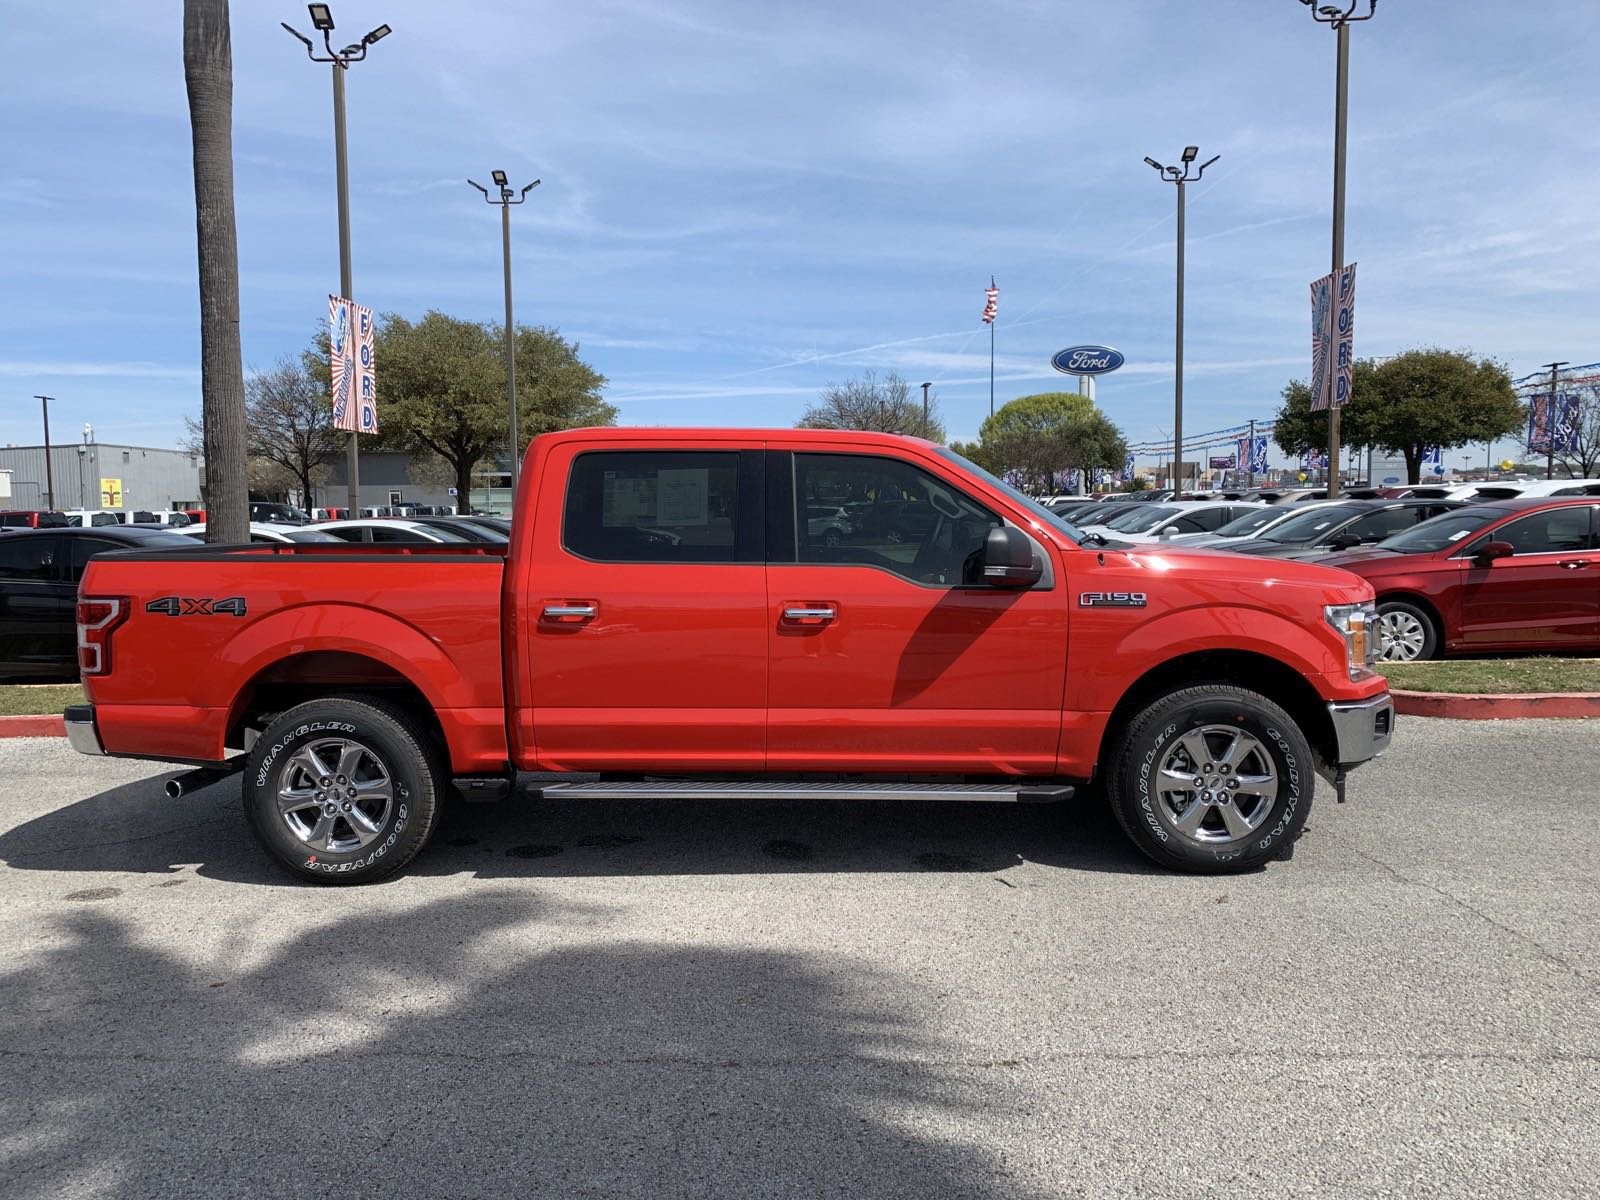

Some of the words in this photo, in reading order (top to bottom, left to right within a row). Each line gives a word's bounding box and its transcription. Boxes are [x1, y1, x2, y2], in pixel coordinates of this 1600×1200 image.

[360, 313, 372, 428] FORD
[1068, 350, 1110, 369] Ford
[1336, 273, 1350, 400] FORD
[1252, 443, 1268, 469] Ford
[256, 721, 356, 787] WRANGLER
[1139, 723, 1177, 843] WRANGLER
[1259, 727, 1300, 849] GOODYEAR
[304, 803, 408, 873] GOODYEAR
